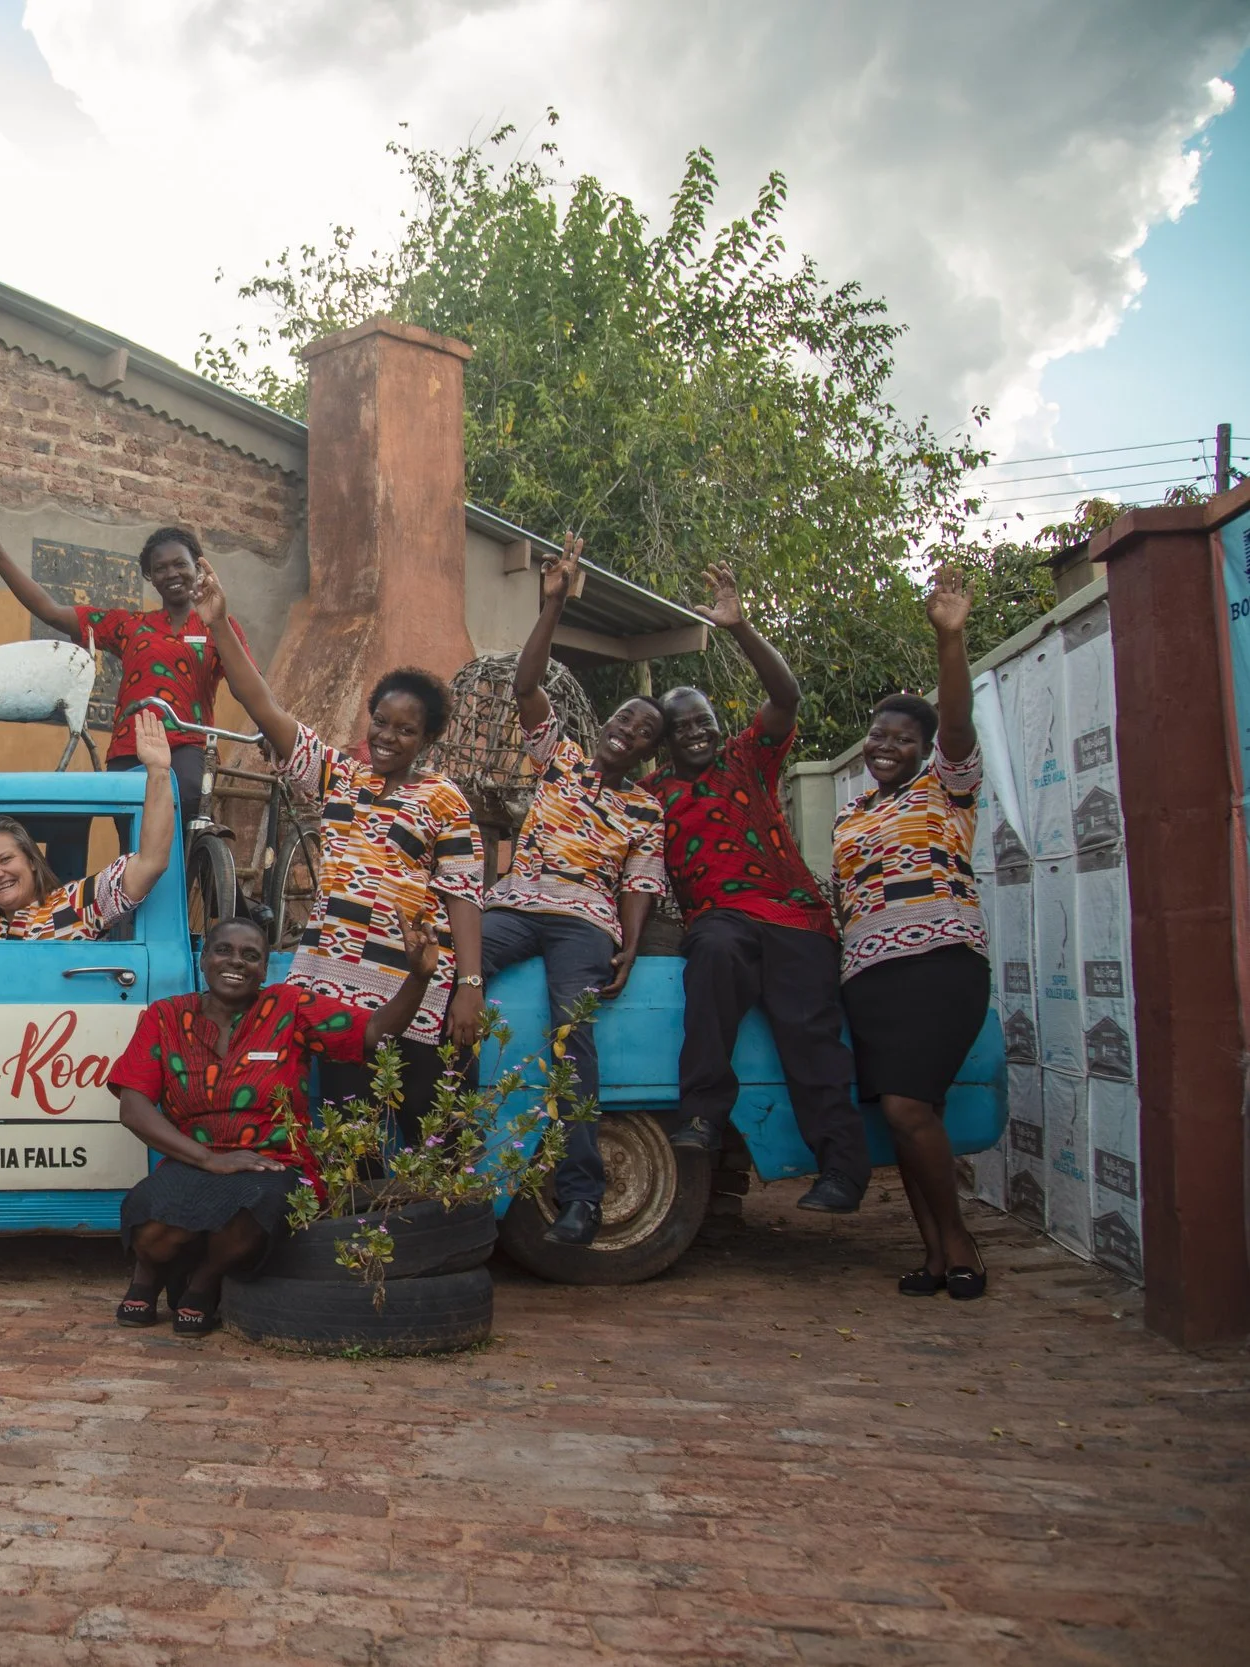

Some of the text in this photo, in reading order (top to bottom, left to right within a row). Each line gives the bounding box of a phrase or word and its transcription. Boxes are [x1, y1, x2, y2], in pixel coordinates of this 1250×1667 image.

[1230, 598, 1250, 621] BO
[2, 1010, 146, 1115] Roa
[24, 1147, 88, 1169] FALLS
